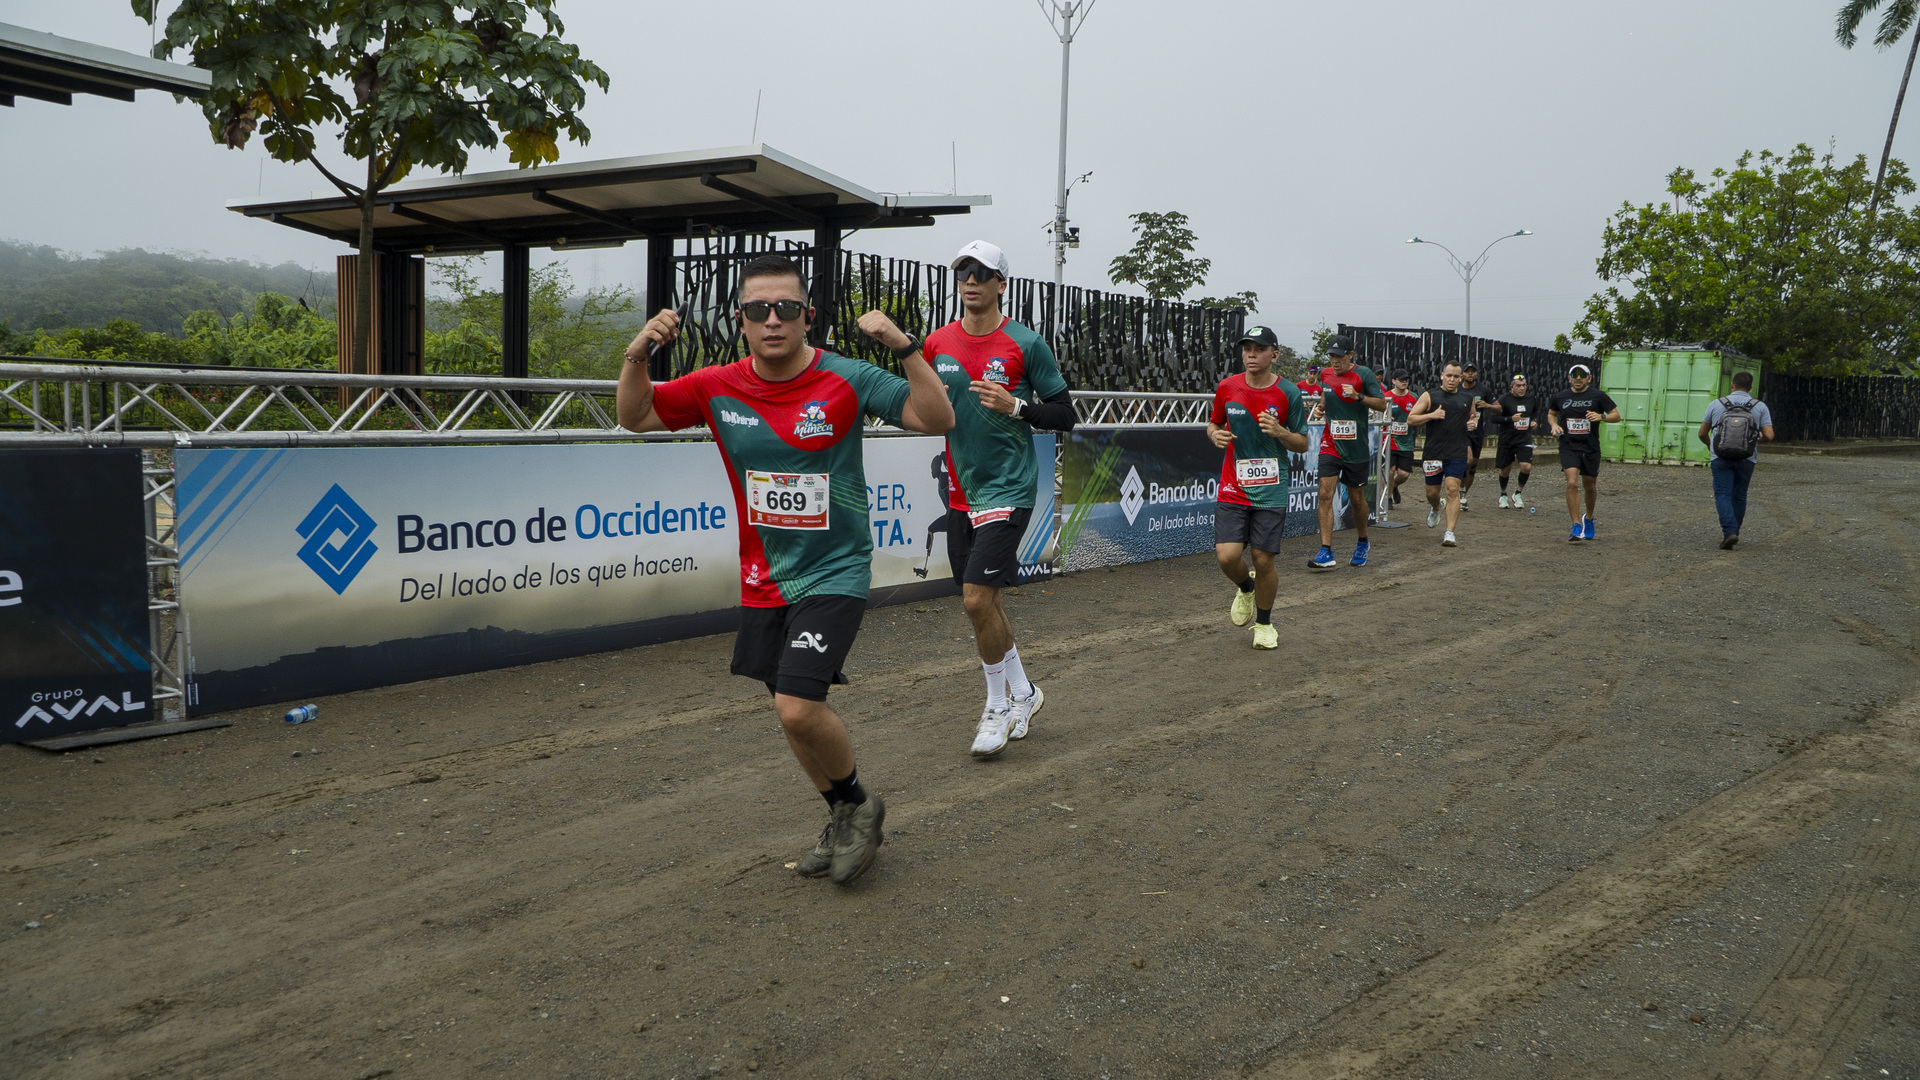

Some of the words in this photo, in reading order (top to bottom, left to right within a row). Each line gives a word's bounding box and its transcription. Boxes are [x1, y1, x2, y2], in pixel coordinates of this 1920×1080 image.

[1335, 426, 1350, 434] 819
[1247, 467, 1268, 478] 909
[766, 490, 807, 511] 669
[1149, 482, 1188, 505] Banco
[1189, 479, 1205, 501] de
[397, 514, 517, 554] Banco
[525, 507, 567, 544] de
[575, 500, 726, 540] Occidente
[1148, 513, 1164, 532] Del
[1164, 513, 1183, 530] lado
[1184, 511, 1195, 526] de
[1196, 511, 1208, 525] los
[400, 573, 443, 603] Del
[451, 568, 507, 597] lado
[513, 564, 542, 590] de
[549, 562, 581, 586] los
[587, 562, 626, 587] que
[633, 554, 698, 577] hacen.
[1017, 563, 1051, 577] AVAL
[31, 688, 83, 702] Grupo
[15, 691, 146, 728] AVAL
